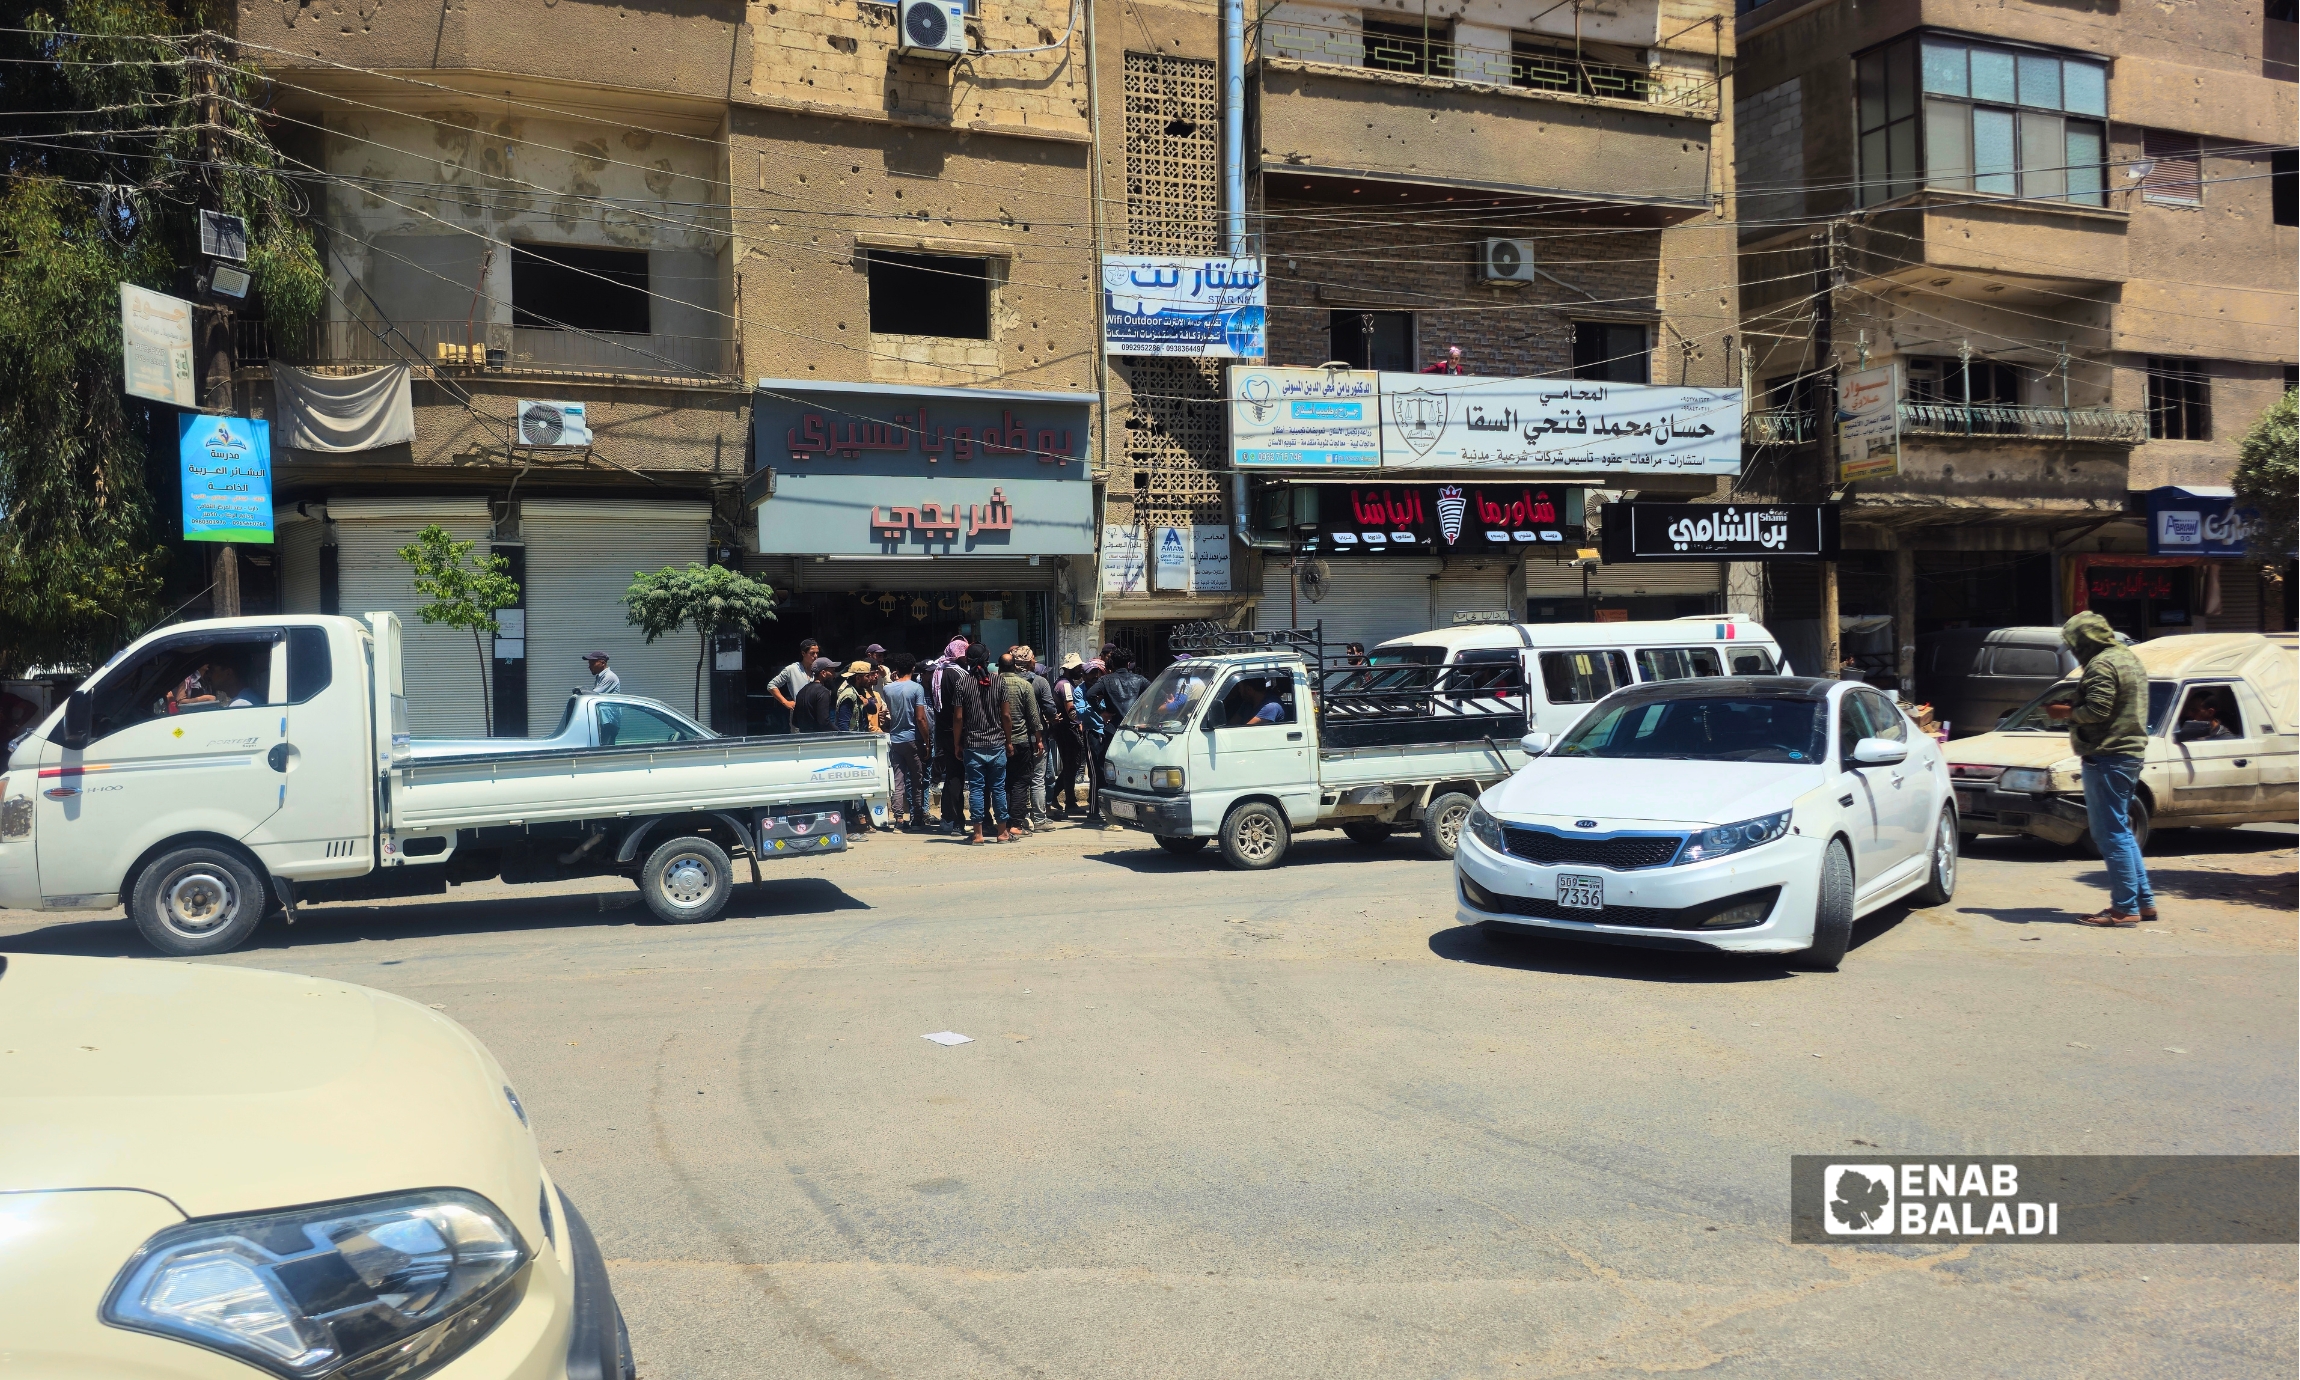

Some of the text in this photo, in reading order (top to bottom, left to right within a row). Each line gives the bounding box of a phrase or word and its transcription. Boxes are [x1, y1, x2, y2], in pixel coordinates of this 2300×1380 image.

[1130, 262, 1260, 298] ستار نت
[1124, 316, 1162, 326] Outdoor
[1540, 384, 1608, 406] المحامي
[1466, 406, 1716, 446] حسان محمد فتحي السقا
[210, 449, 240, 461] مدرسة
[1461, 448, 1490, 462] مدنية
[1534, 450, 1564, 465] شركات
[1601, 451, 1623, 467] عقود
[1629, 451, 1662, 468] مرافعات
[1668, 452, 1705, 468] استشارات
[188, 464, 227, 477] العربية
[207, 481, 249, 492] الخاصة
[871, 486, 1013, 539] شربجي
[1351, 489, 1556, 531] شاورما الباشا
[1759, 512, 1788, 522] Shami
[1668, 507, 1788, 550] الشامي بن
[810, 769, 875, 781] AL ERUBEN
[1560, 877, 1577, 887] 509
[1560, 887, 1600, 906] 7336
